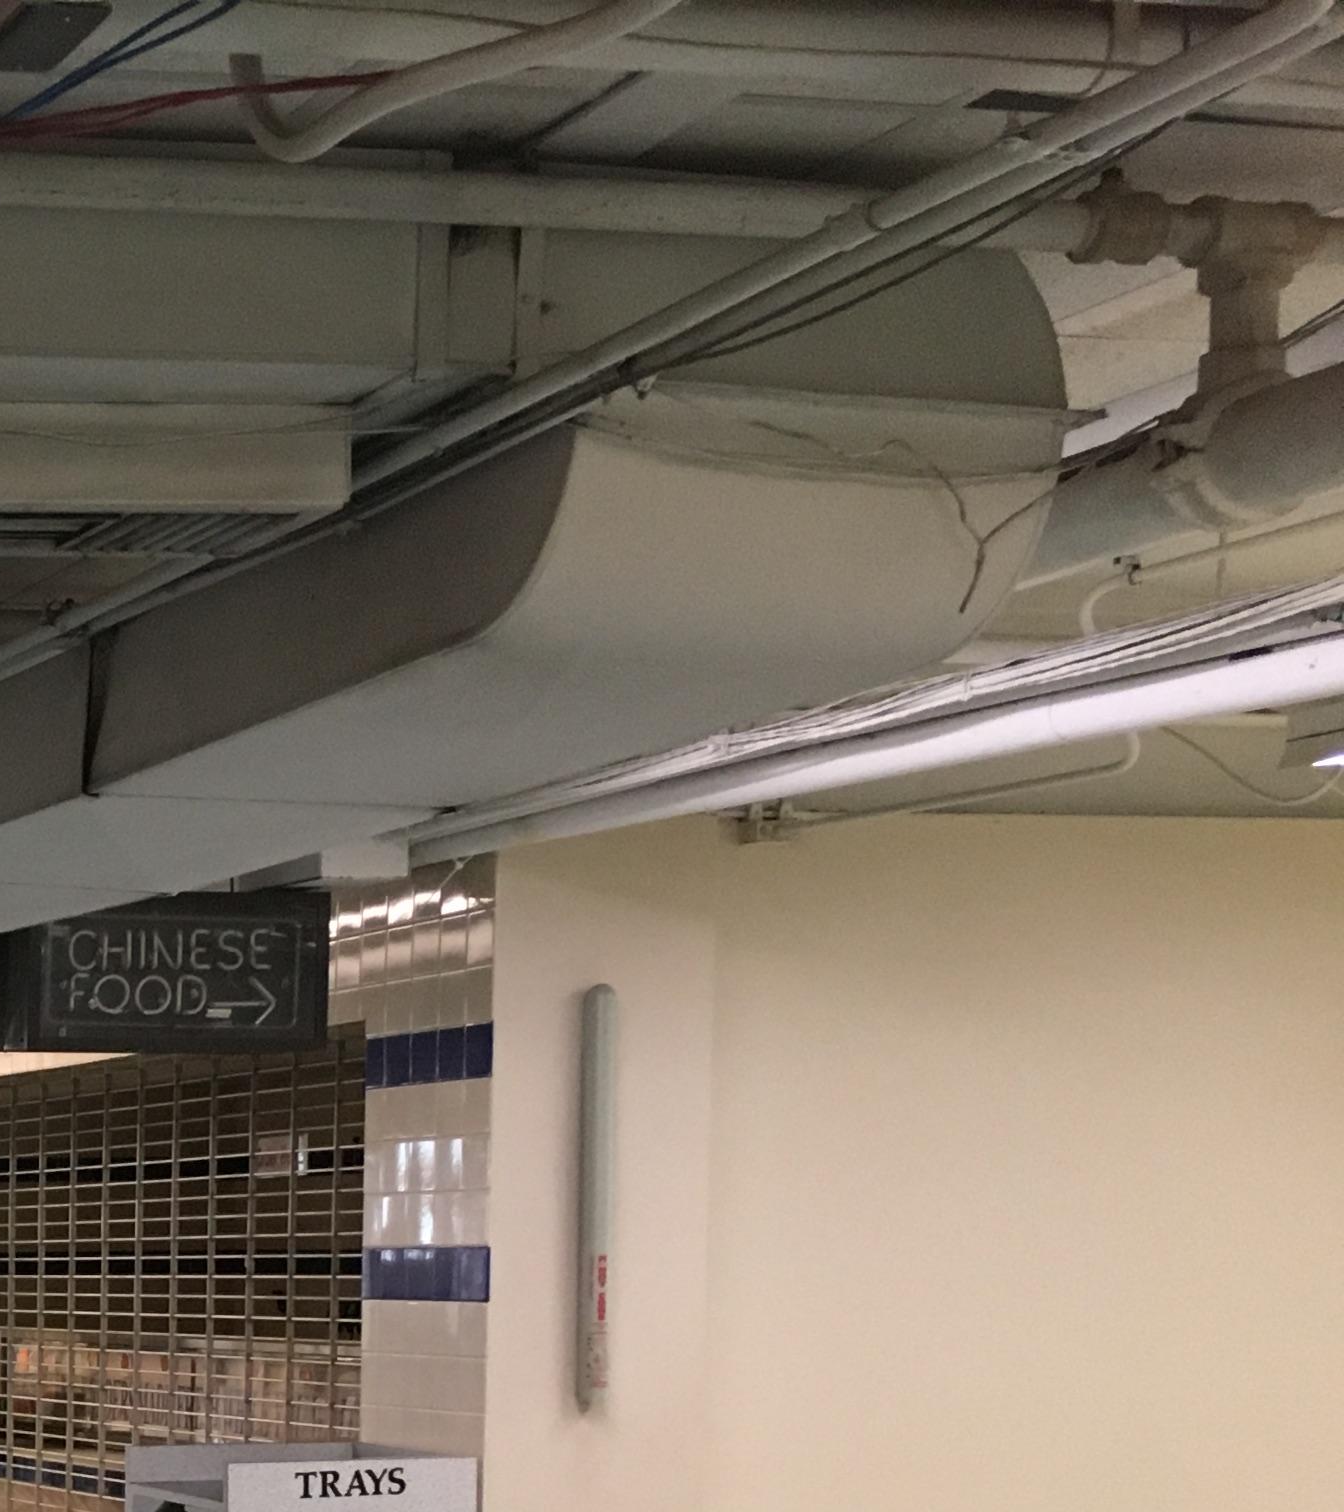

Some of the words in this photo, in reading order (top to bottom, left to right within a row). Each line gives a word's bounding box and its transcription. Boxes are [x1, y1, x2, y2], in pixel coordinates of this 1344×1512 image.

[69, 929, 272, 971] CHINESE
[70, 973, 207, 1014] FOOD
[295, 1467, 406, 1499] TRAYS
